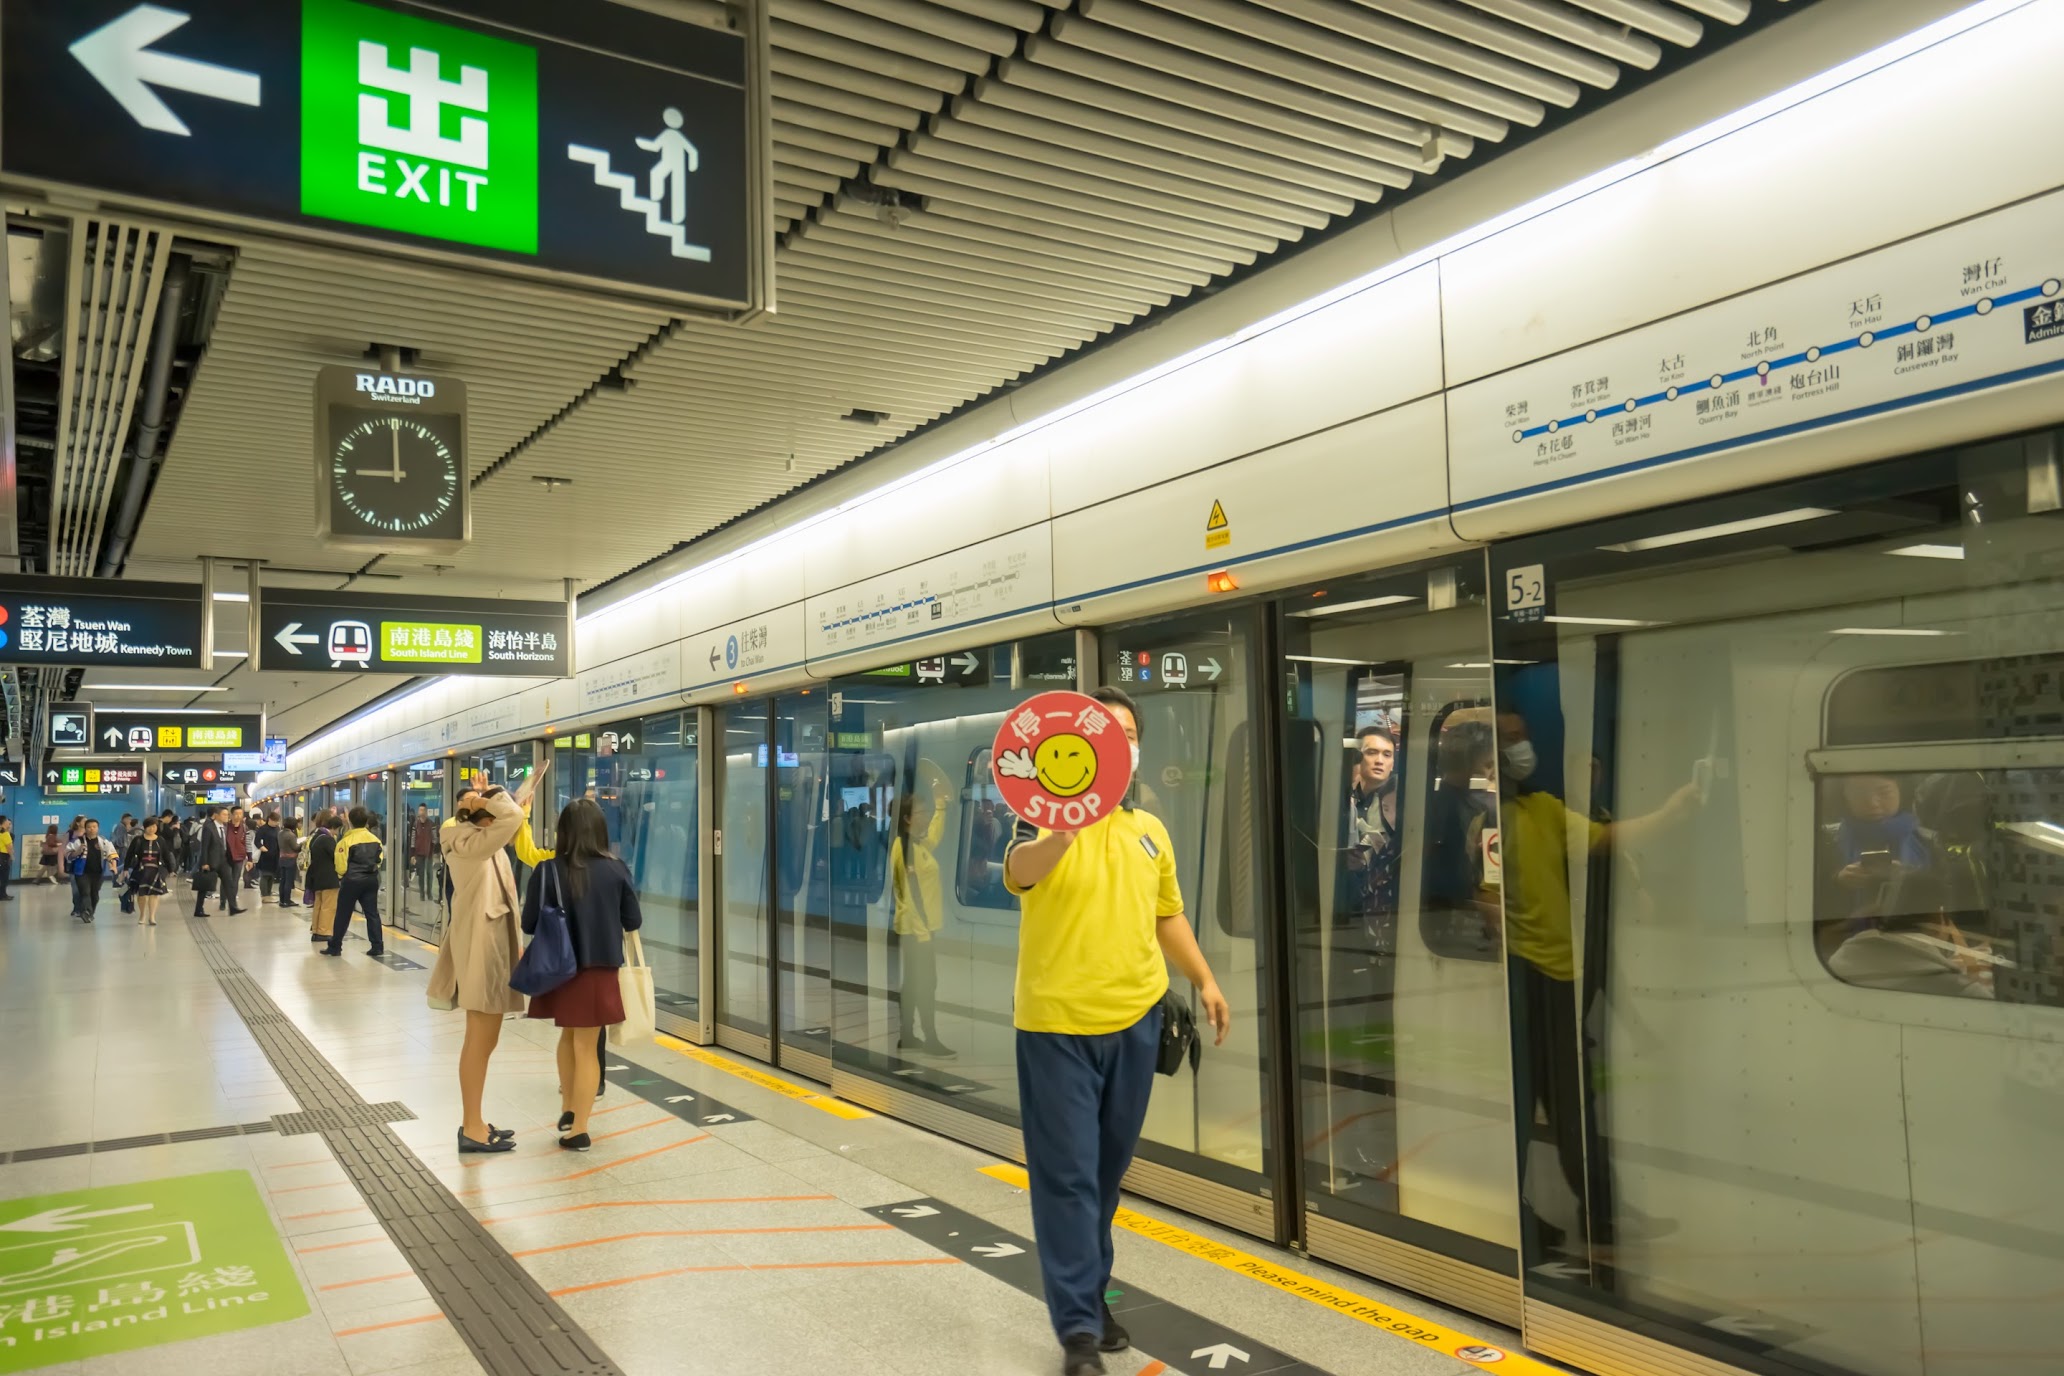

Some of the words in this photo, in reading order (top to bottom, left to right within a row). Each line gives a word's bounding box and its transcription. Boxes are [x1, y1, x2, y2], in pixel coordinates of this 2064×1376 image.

[358, 151, 488, 212] EXIT
[1962, 257, 2003, 284] 灣仔
[1960, 286, 1982, 297] Wan
[1985, 277, 2007, 290] Chai
[1849, 293, 1882, 319] 天后
[1849, 319, 1863, 329] Tin
[1864, 314, 1882, 325] Hau
[1747, 326, 1777, 348] 北角
[1897, 333, 1954, 363] 銅鑼灣
[1741, 348, 1763, 360] North
[1764, 342, 1785, 355] Point
[1659, 353, 1685, 374] 太古
[1894, 358, 1939, 375] Causeway
[1941, 353, 1959, 364] Bay
[355, 373, 435, 398] RADO
[1659, 376, 1670, 384] Tai
[1670, 371, 1685, 381] Koo
[1790, 364, 1840, 391] 炮台山
[371, 392, 421, 405] Switzerland
[1791, 388, 1824, 401] Fortress
[1825, 382, 1840, 394] Hill
[1612, 414, 1652, 438] 西灣河
[1698, 413, 1724, 425] Quarry
[1724, 410, 1738, 420] Bay
[1624, 435, 1639, 444] Wan
[1511, 574, 1542, 605] 5-2
[20, 605, 71, 630] 荃灣
[73, 619, 106, 631] Tsuen
[106, 620, 131, 632] Wan
[19, 629, 118, 654] 堅尼地城
[390, 626, 475, 649] 南港島綫
[488, 629, 557, 651] 海怡半島
[120, 644, 165, 657] Kennedy
[165, 645, 193, 656] Town
[390, 648, 418, 658] South
[419, 648, 447, 658] Island
[448, 649, 468, 659] Line
[488, 650, 515, 660] South
[516, 651, 555, 661] Horizons
[729, 641, 736, 664] 3
[1010, 705, 1111, 744] 停一停
[1023, 792, 1101, 826] STOP
[1235, 1261, 1298, 1288] Please
[1296, 1285, 1358, 1309] mind
[1352, 1302, 1392, 1324] the
[1386, 1320, 1440, 1343] gap
[34, 1305, 168, 1342] Island
[182, 1291, 270, 1314] Line
